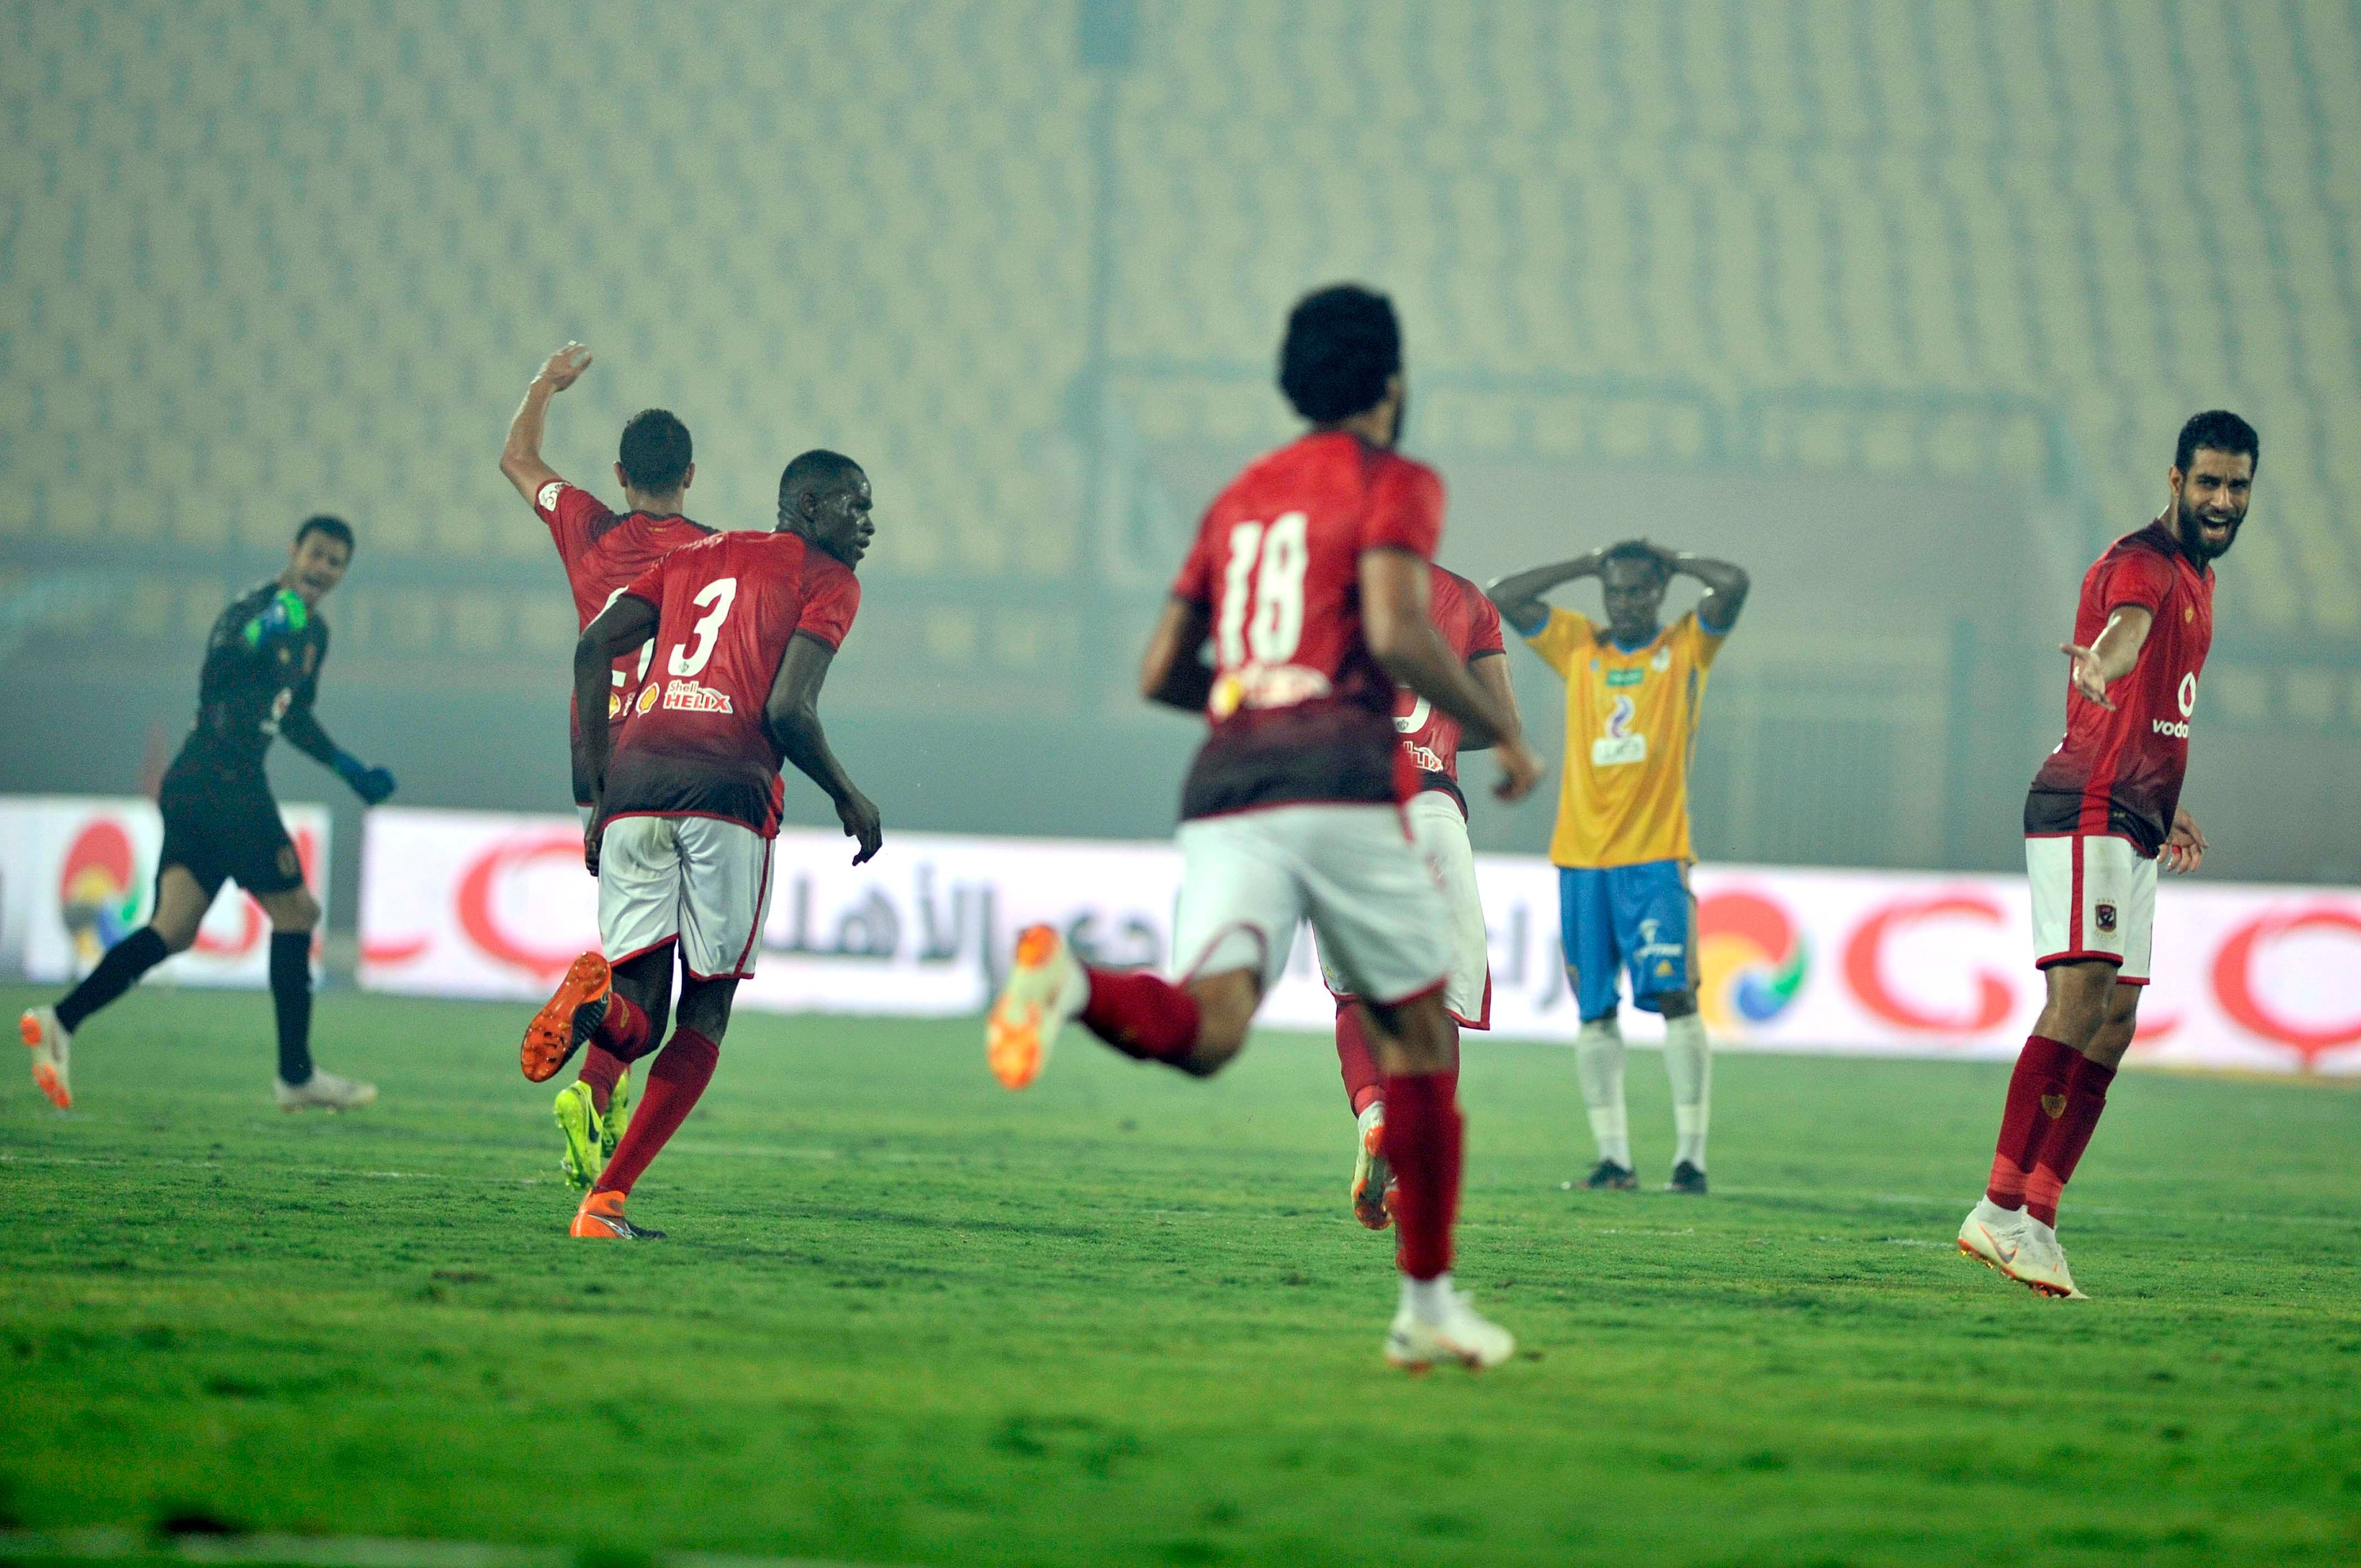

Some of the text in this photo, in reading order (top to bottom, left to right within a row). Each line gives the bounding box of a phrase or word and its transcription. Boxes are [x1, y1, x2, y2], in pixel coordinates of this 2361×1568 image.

[1219, 509, 1308, 667] 18
[668, 578, 737, 677] 3
[665, 694, 729, 711] HELIX
[670, 682, 698, 693] Shell
